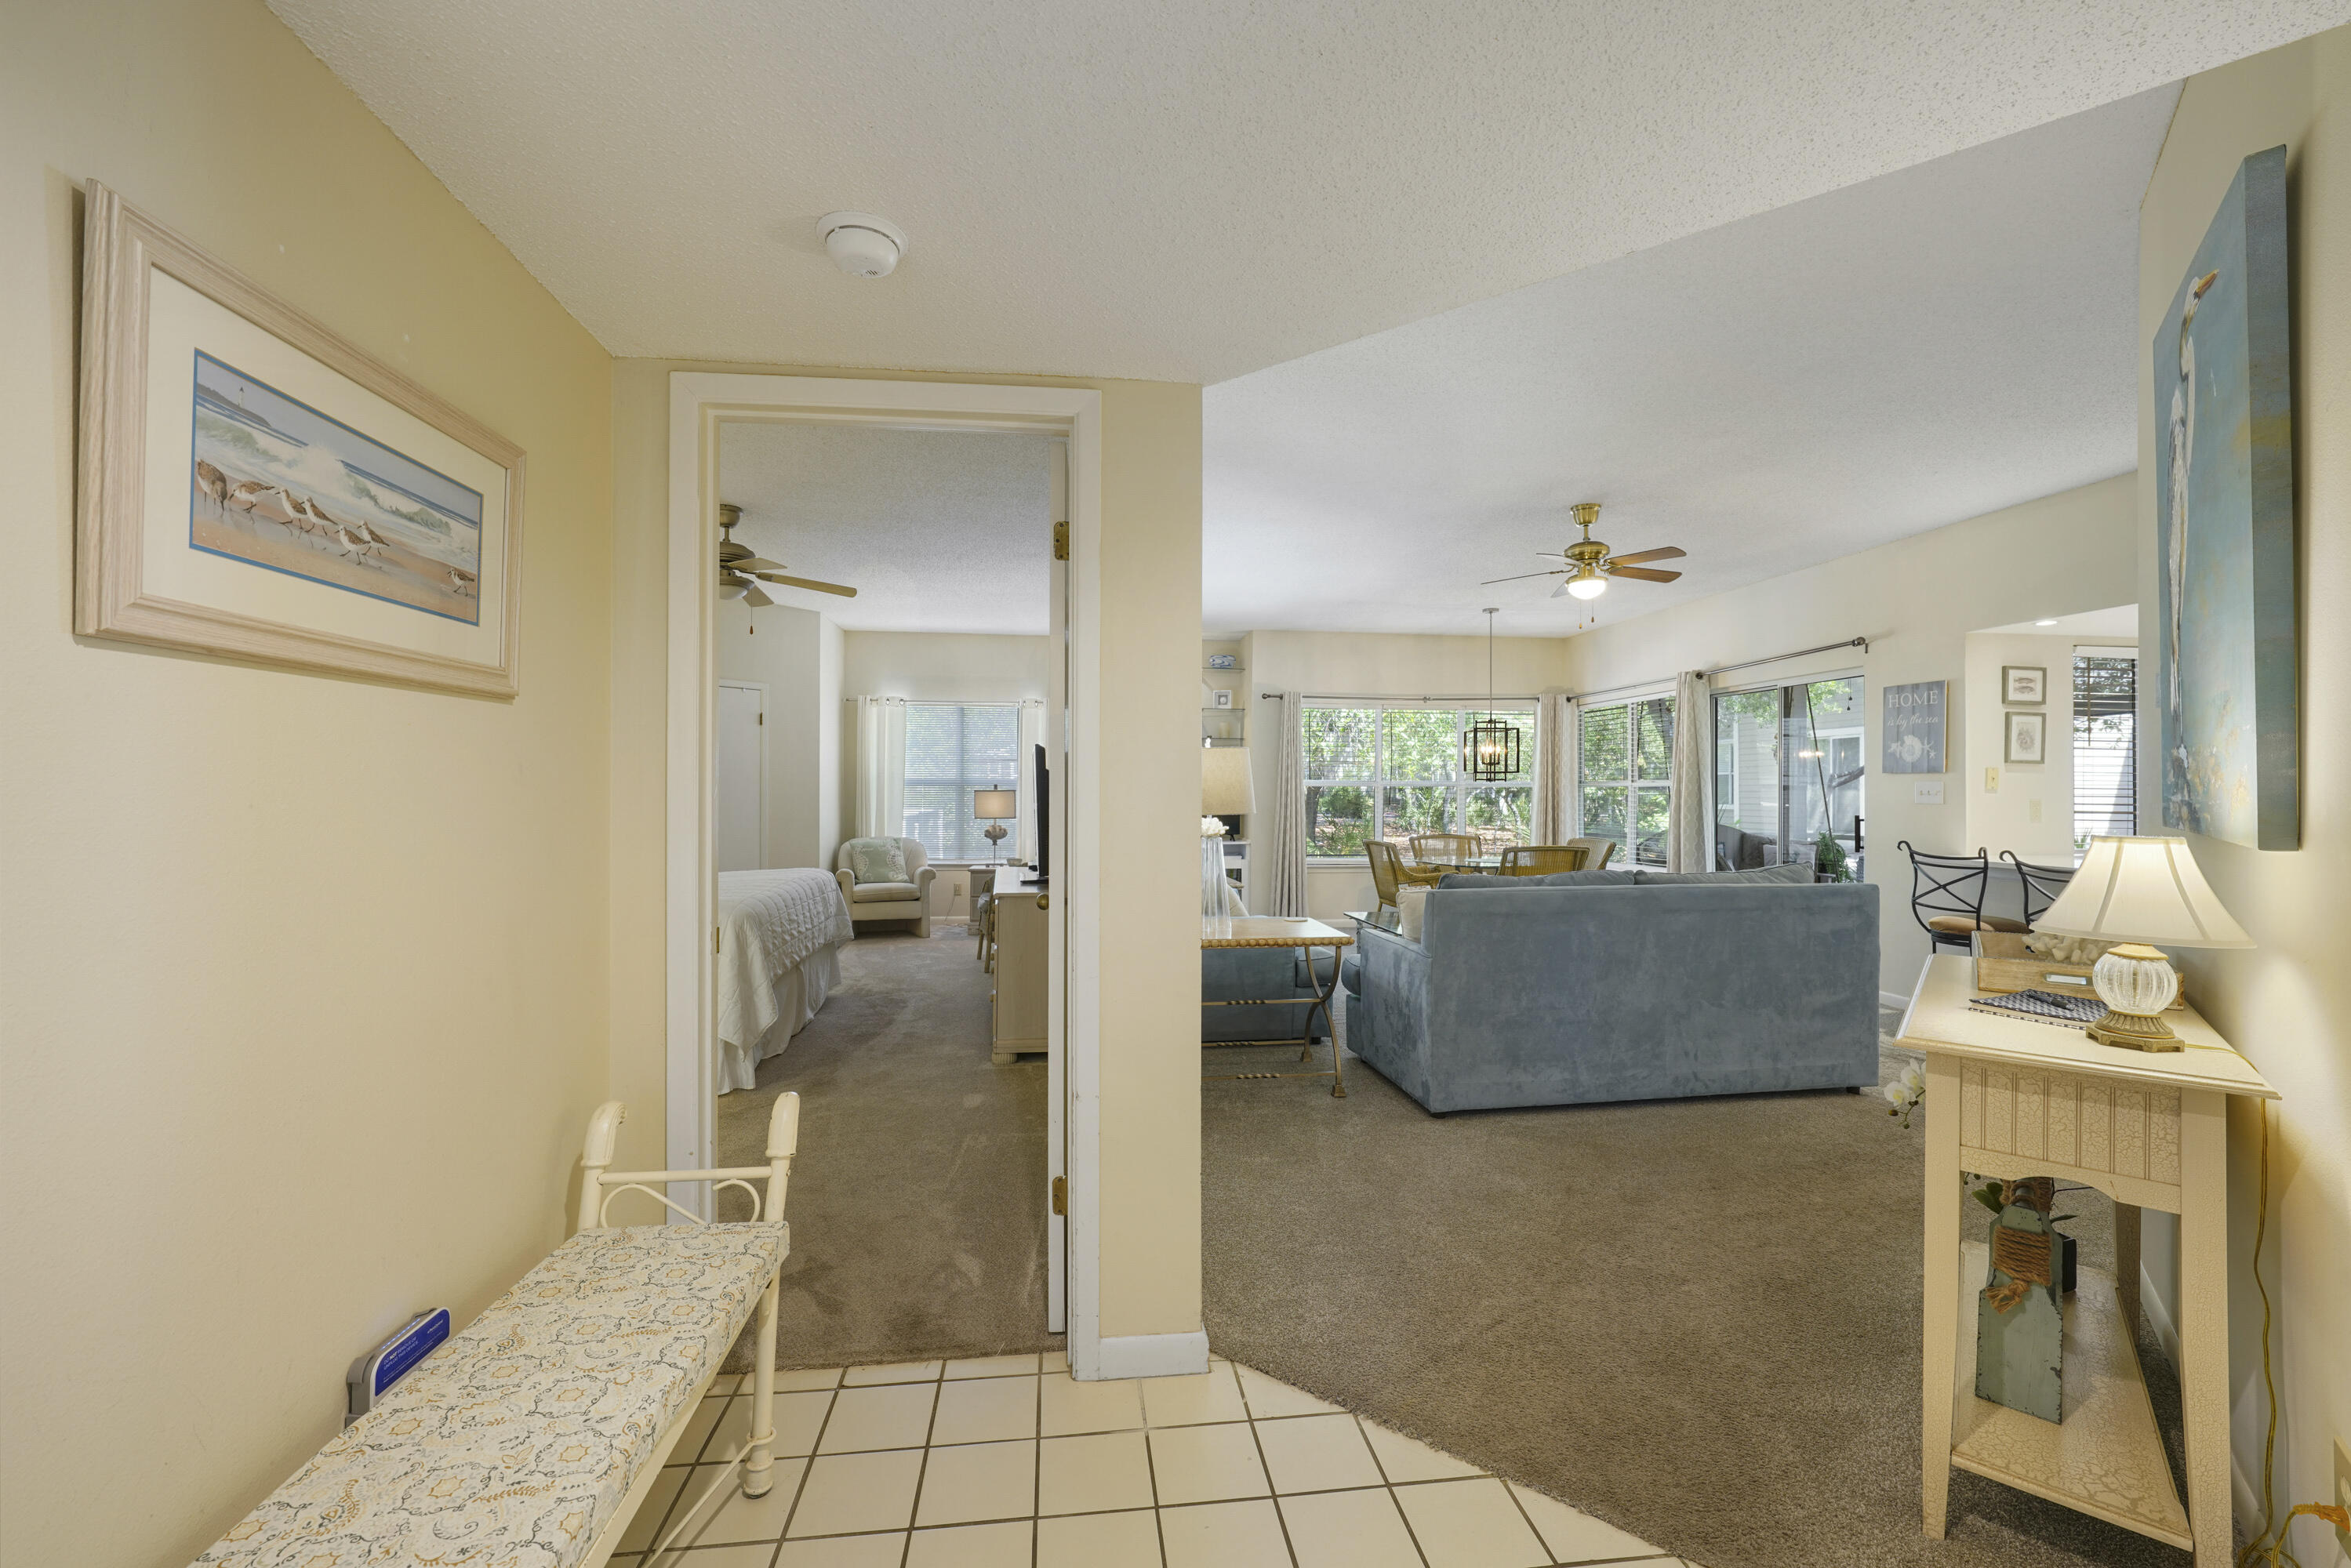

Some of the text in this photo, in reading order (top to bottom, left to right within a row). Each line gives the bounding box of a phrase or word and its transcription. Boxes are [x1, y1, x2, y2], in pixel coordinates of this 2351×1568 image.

[1888, 690, 1939, 708] HOME
[1888, 713, 1939, 731] is by the sea
[389, 1351, 398, 1360] NOT
